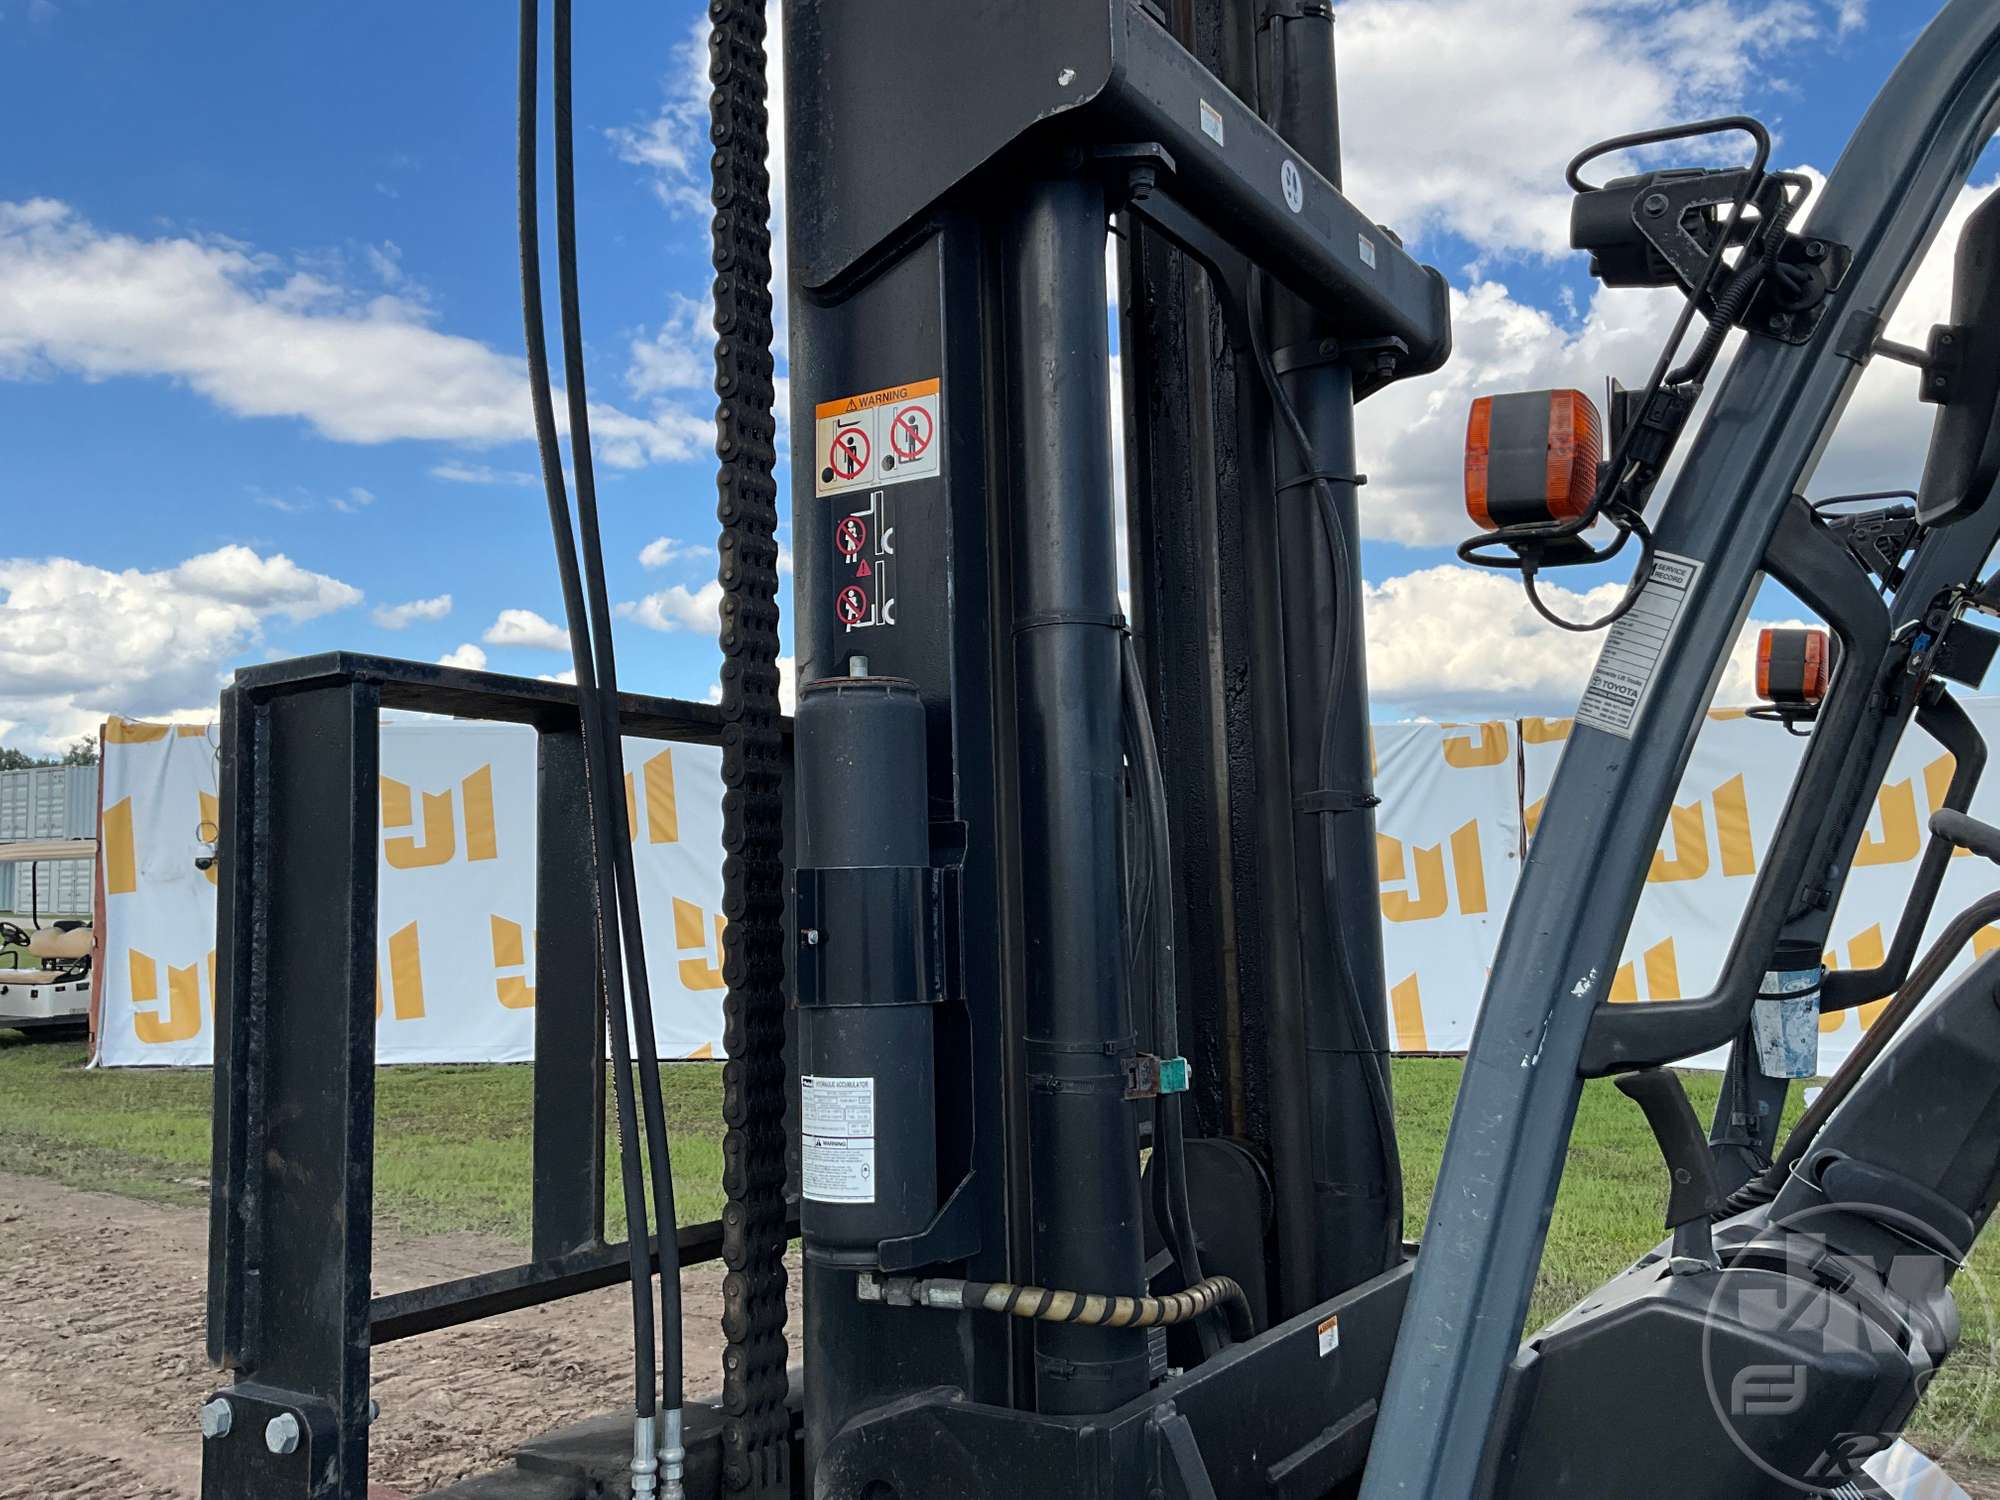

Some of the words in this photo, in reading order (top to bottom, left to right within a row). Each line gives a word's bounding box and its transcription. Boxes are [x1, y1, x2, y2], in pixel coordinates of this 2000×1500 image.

[859, 388, 908, 407] WARNING
[1657, 563, 1687, 576] SERVICE
[1654, 571, 1684, 584] RECORD
[1602, 680, 1638, 698] TOYOTA
